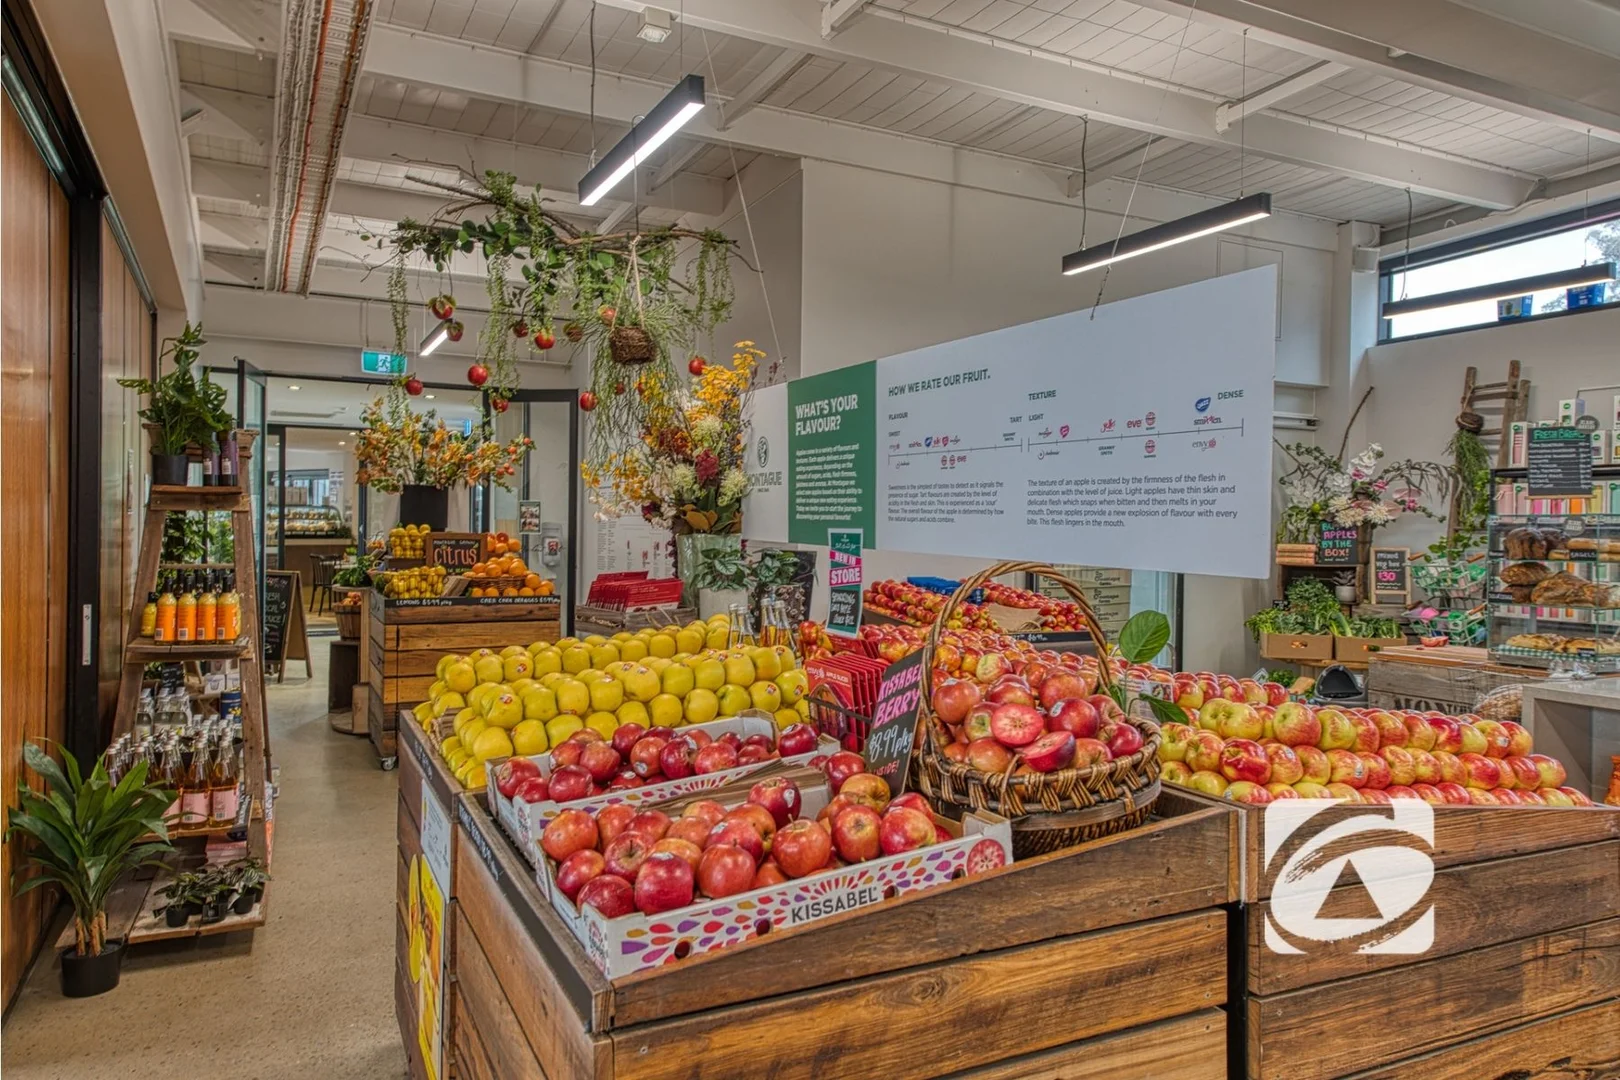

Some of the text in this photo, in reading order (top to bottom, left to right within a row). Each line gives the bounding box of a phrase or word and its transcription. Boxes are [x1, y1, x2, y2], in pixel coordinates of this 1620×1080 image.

[888, 369, 991, 397] HOW WE RATE OUR FRUIT.
[1029, 390, 1056, 400] TEXTURE
[1218, 390, 1244, 400] DENSE
[796, 394, 858, 419] WHAT'S YOUR
[888, 412, 908, 420] FLAVOUR
[796, 415, 841, 436] FLAVOUR?
[1127, 419, 1142, 428] eve
[1074, 477, 1090, 487] apple
[1122, 476, 1130, 485] by
[1144, 475, 1173, 483] firmness
[966, 490, 972, 499] by
[1107, 487, 1124, 496] juice.
[1125, 487, 1142, 496] Light
[1143, 486, 1166, 496] apples
[1203, 485, 1218, 494] skin
[1220, 485, 1236, 493] and
[1064, 508, 1083, 517] apples
[1084, 509, 1106, 517] provide
[1127, 509, 1160, 518] explosion
[1216, 510, 1238, 519] every
[1065, 519, 1085, 528] lingers
[1324, 531, 1357, 539] APPLES
[434, 546, 477, 565] citrus
[835, 552, 856, 565] NEW IN
[831, 568, 860, 584] STORE
[878, 663, 922, 702] KISSABEL
[874, 688, 920, 729] BERRY
[792, 887, 878, 923] KISSABEL
